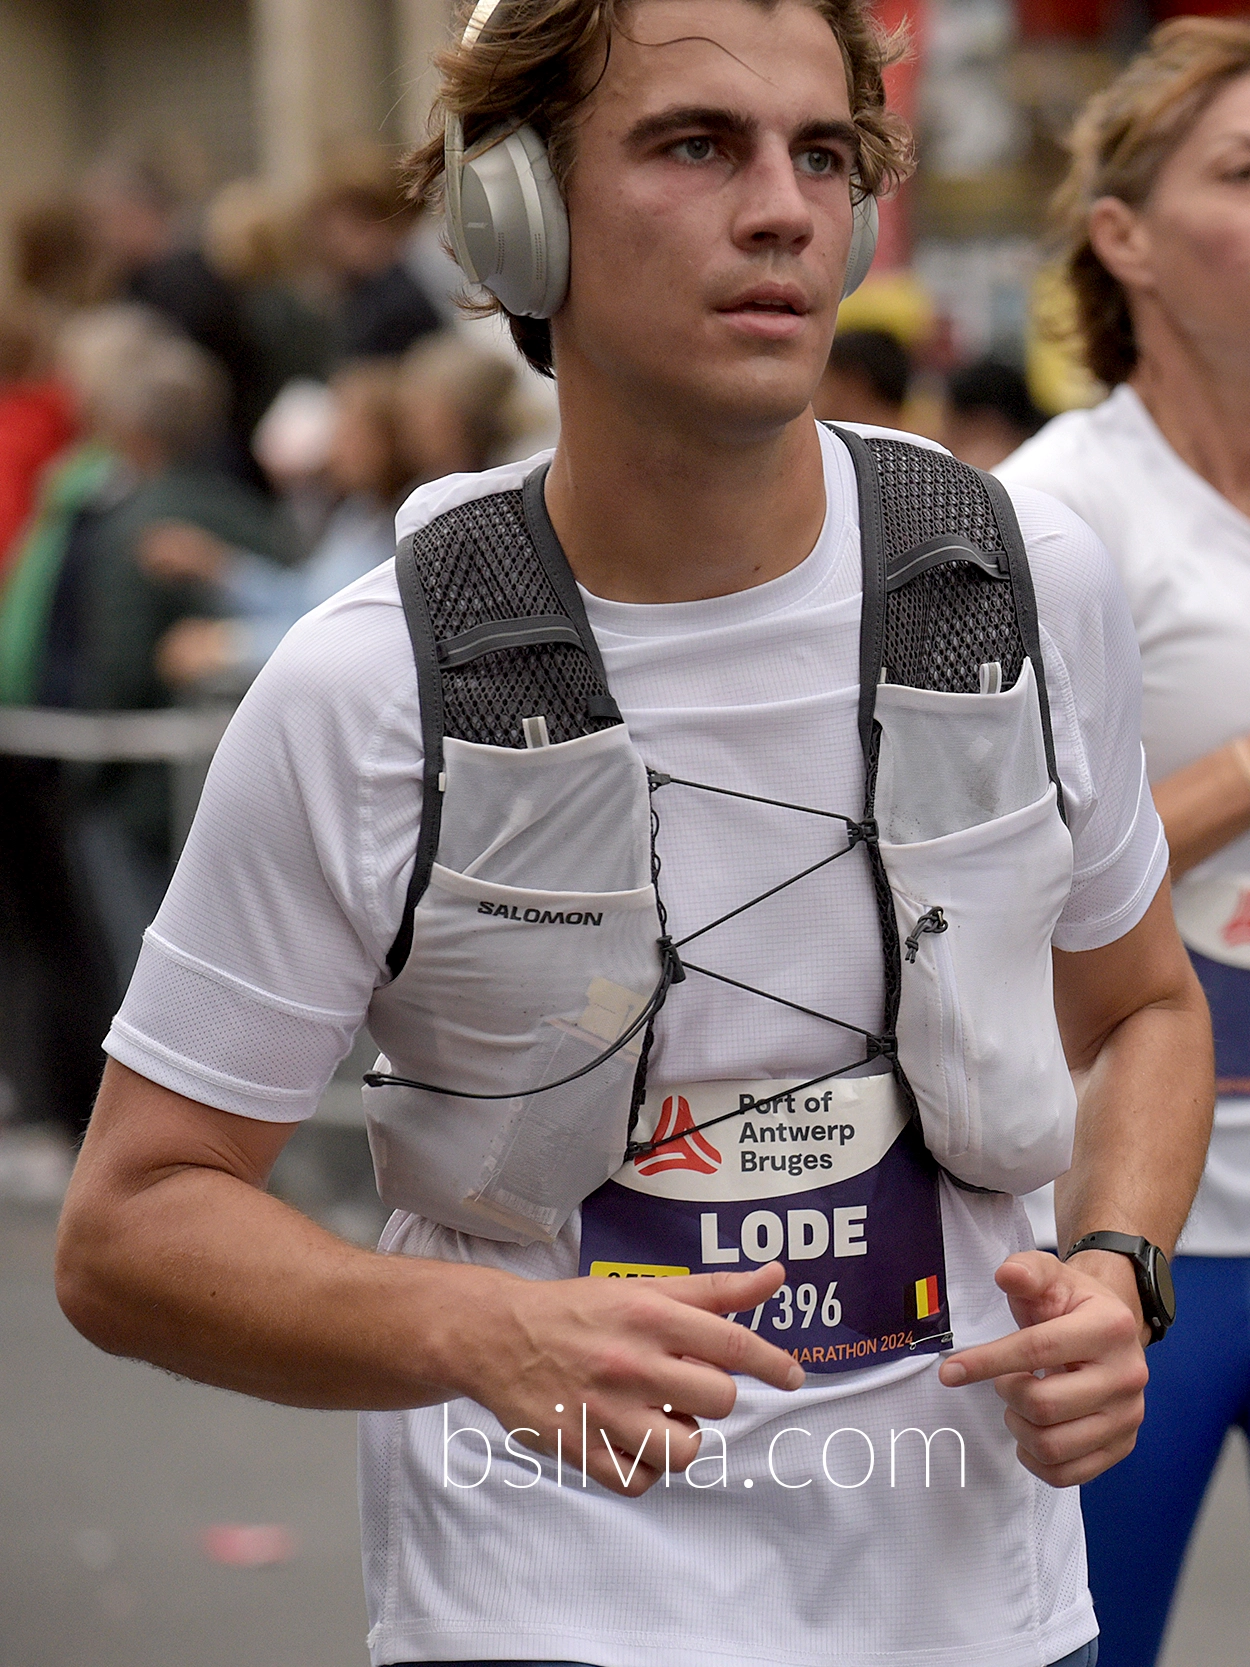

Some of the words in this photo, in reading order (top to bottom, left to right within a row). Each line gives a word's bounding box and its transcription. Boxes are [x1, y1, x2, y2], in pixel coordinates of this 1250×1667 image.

[477, 901, 603, 926] SALOMON
[738, 1091, 796, 1115] Port
[804, 1090, 833, 1113] of
[738, 1121, 856, 1146] Antwerp
[740, 1150, 833, 1177] Bruges
[701, 1205, 868, 1264] LODE
[785, 1339, 877, 1364] MARATHON
[880, 1330, 914, 1351] 2024
